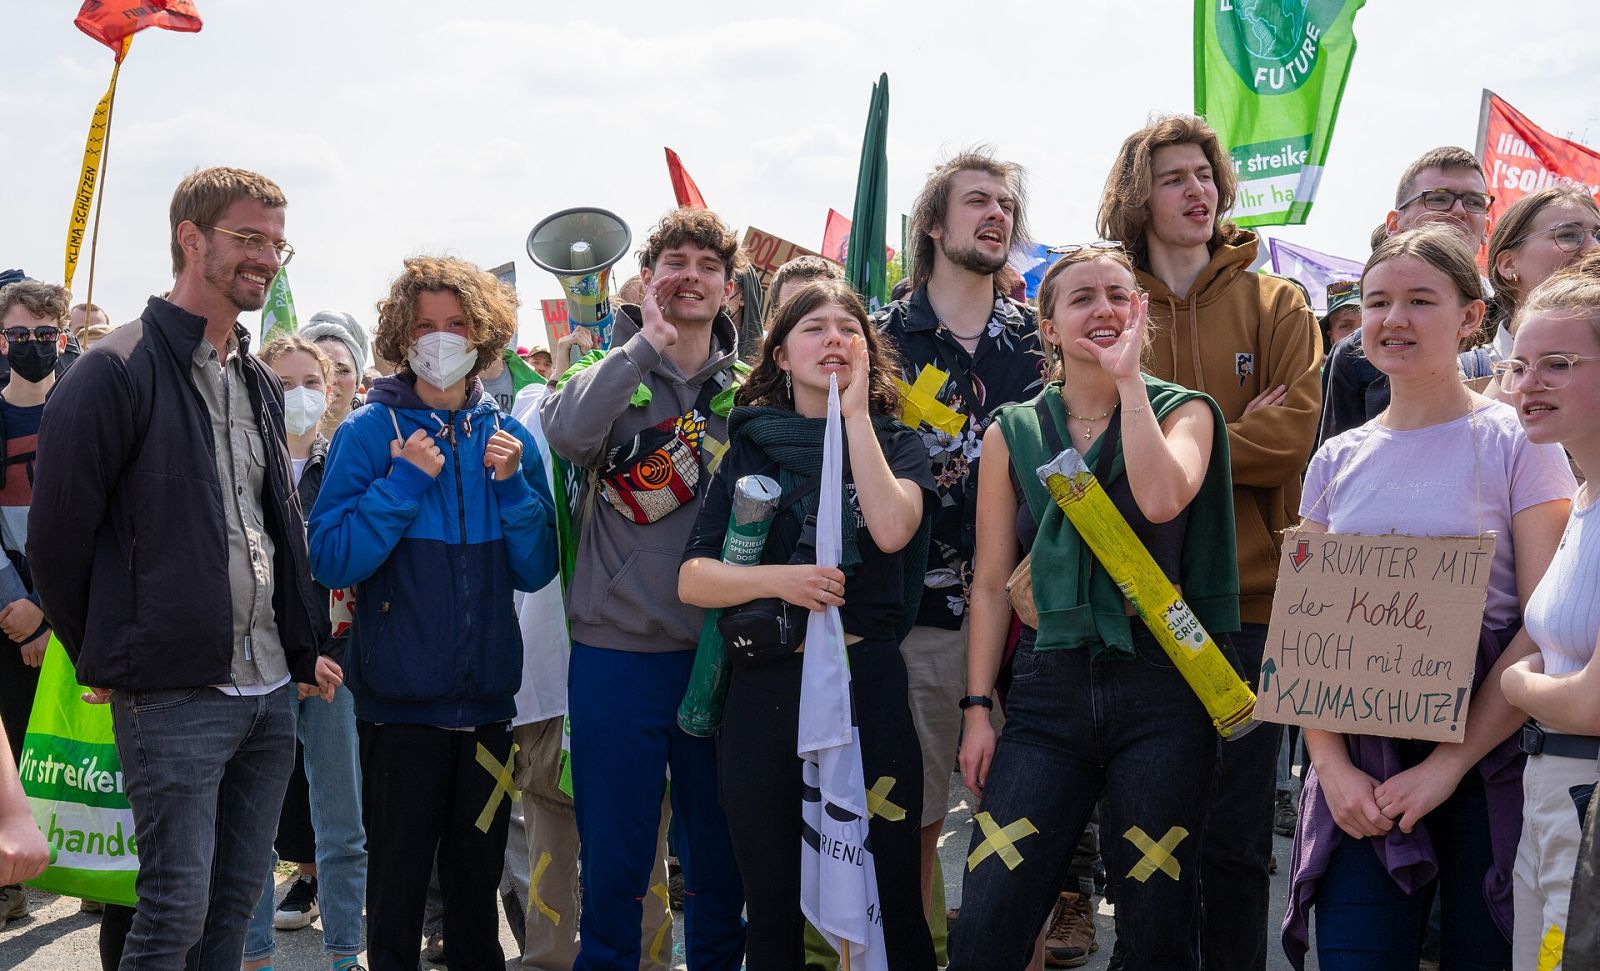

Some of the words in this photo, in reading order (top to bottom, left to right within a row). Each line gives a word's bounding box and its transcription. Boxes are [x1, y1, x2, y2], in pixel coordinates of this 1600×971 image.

[1254, 21, 1321, 90] FUTURE
[74, 165, 97, 225] SCHÜTZEN
[1239, 187, 1265, 209] Ihr
[68, 228, 84, 264] KLIMA
[1321, 541, 1418, 579] RUNTER
[1432, 550, 1488, 585] MIT
[1287, 587, 1334, 617] der
[1346, 586, 1433, 638] Kohle,
[1281, 629, 1354, 670] HOCH
[1366, 644, 1402, 674] mit
[1411, 653, 1452, 681] dem
[1275, 674, 1468, 732] KLIMASCHUTZ!
